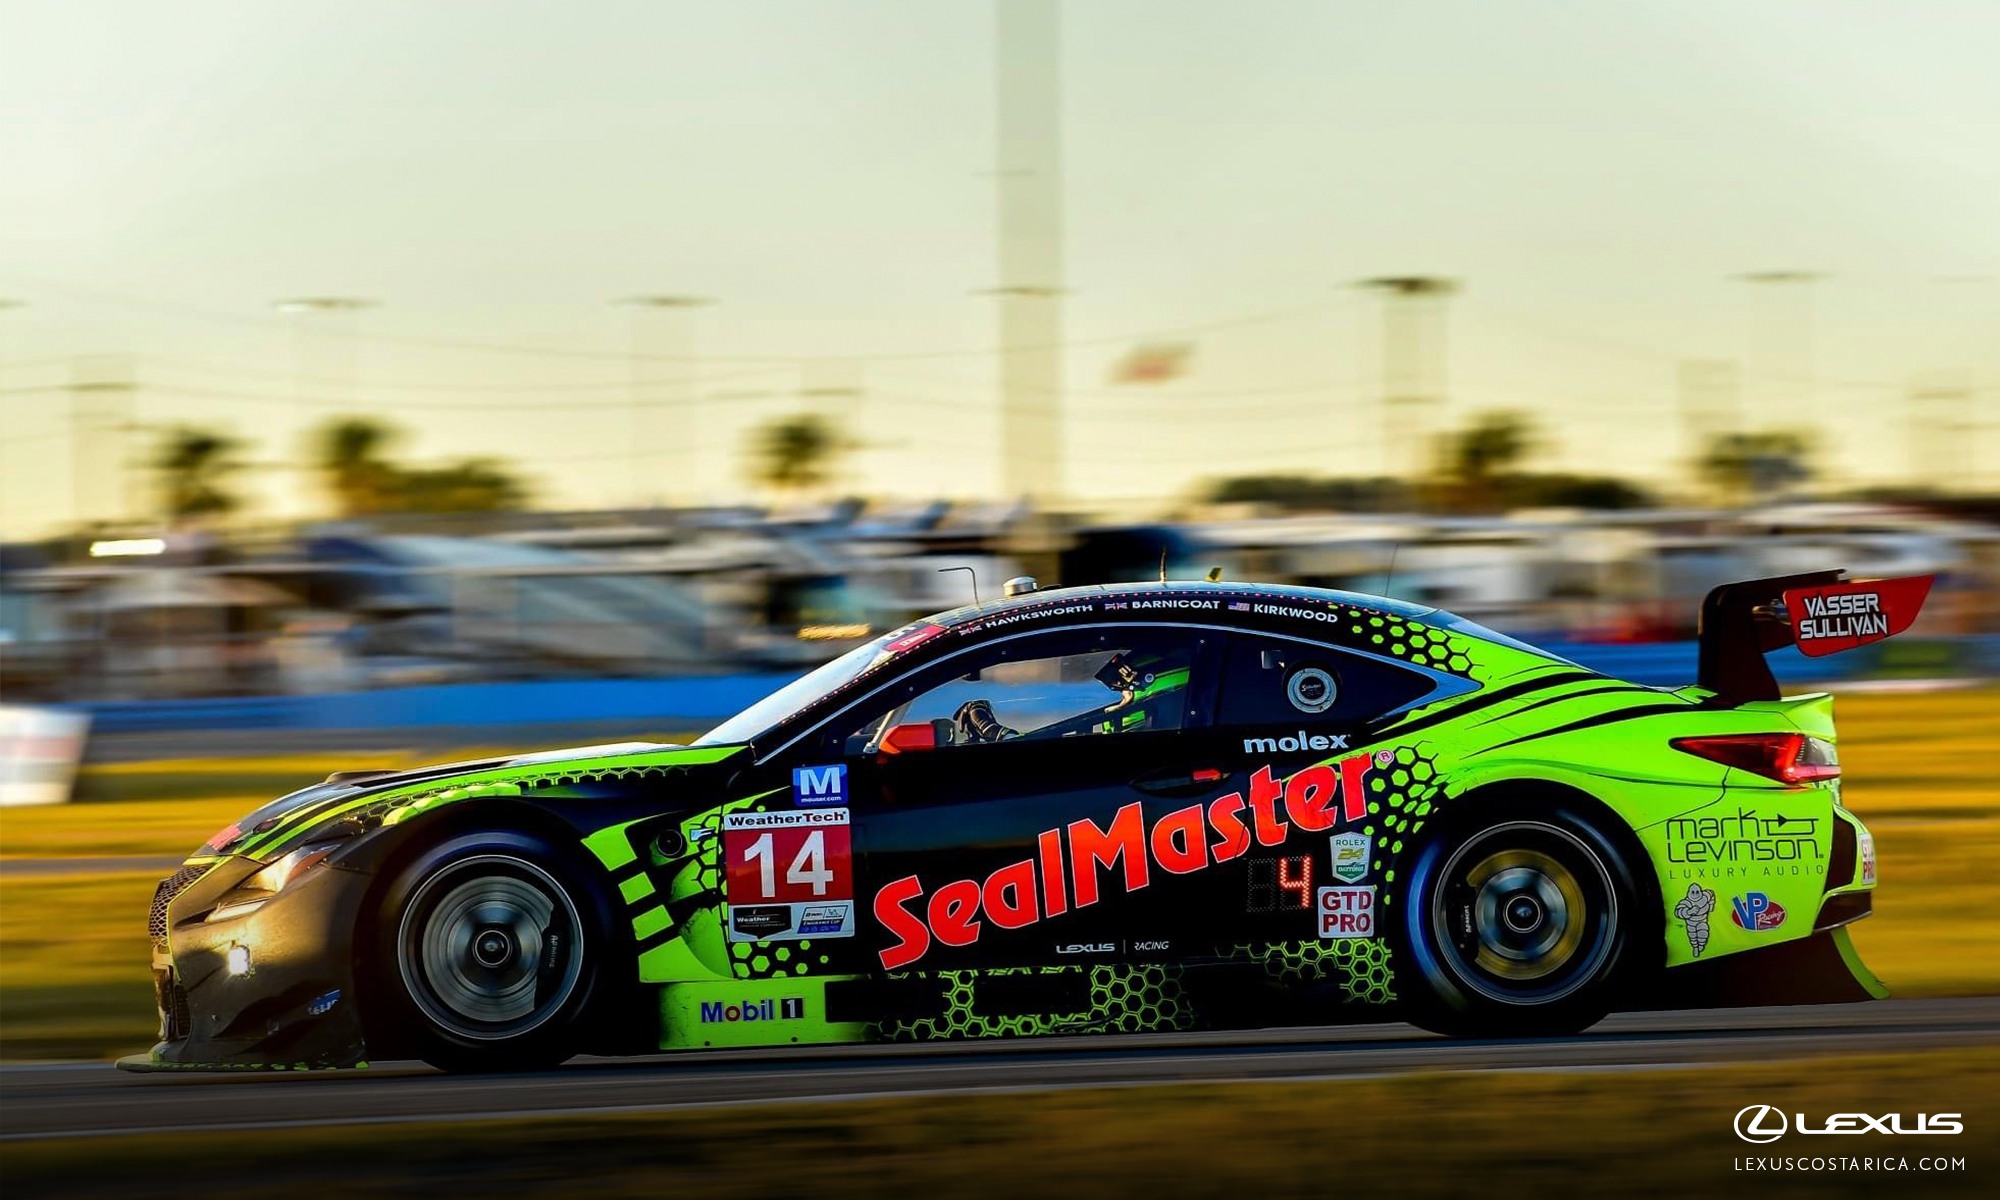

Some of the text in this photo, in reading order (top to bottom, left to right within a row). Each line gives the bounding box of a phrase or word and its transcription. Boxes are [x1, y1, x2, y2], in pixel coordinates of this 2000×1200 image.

[986, 604, 1093, 628] HAWKSWORTH
[1132, 600, 1220, 609] BARNICOAT
[1254, 603, 1338, 623] KIRKWOOD
[1804, 594, 1880, 618] VASSER
[1800, 614, 1888, 639] SULLIVAN
[1243, 730, 1350, 753] molex
[800, 767, 840, 795] M
[729, 811, 844, 826] WeatherTech
[1666, 807, 1760, 839] mark
[744, 830, 834, 897] 14
[874, 752, 1374, 971] SealMaster
[1669, 864, 1825, 880] LUXURY AUDIO
[1280, 854, 1311, 908] 4
[1322, 891, 1371, 911] GTD
[1732, 891, 1769, 931] VP
[1323, 913, 1371, 932] PRO
[1056, 943, 1116, 954] LEXUS
[701, 999, 774, 1023] Mobil
